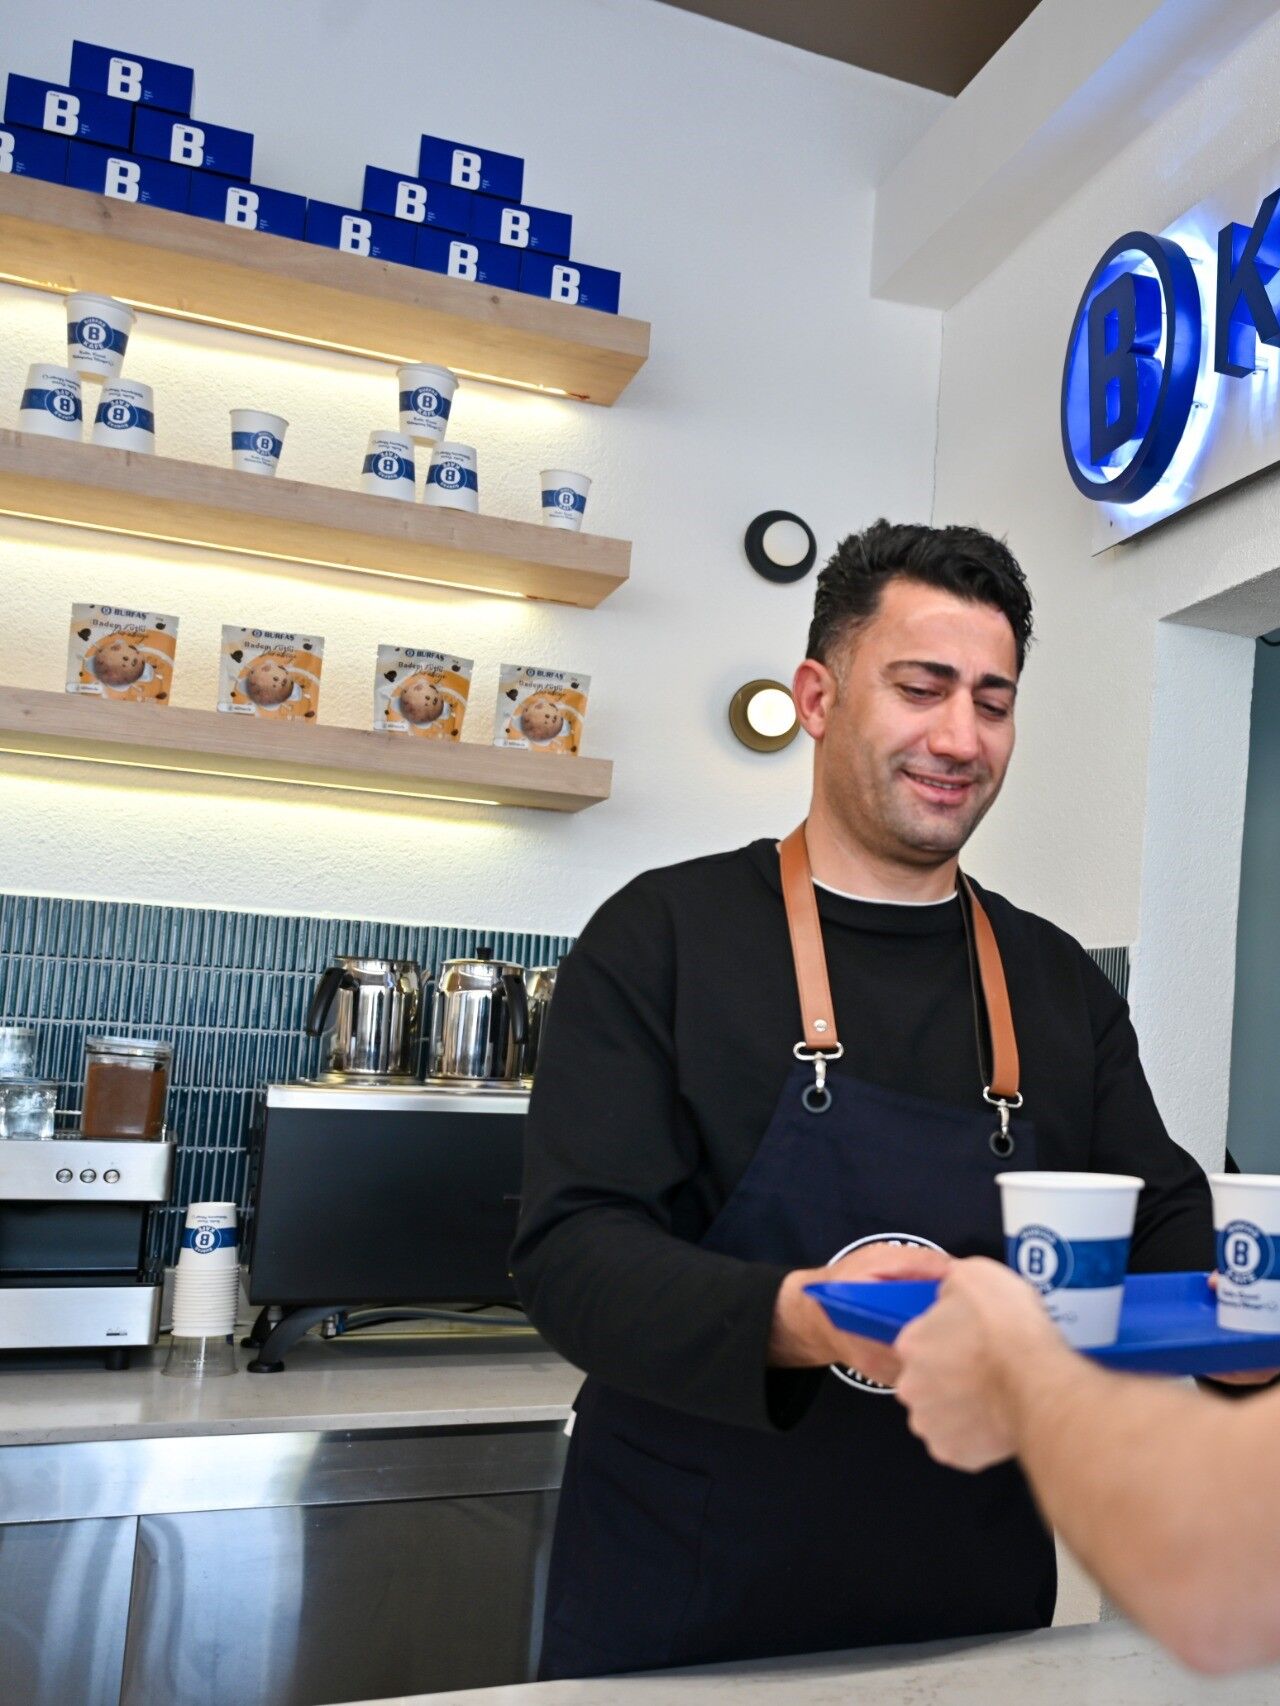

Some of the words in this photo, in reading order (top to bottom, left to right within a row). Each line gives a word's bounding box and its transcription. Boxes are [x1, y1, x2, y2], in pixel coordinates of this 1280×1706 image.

[107, 57, 143, 102] B
[42, 90, 80, 136] B
[170, 123, 205, 167] B
[105, 157, 141, 202] B
[451, 149, 482, 191] B
[225, 187, 259, 230] B
[395, 181, 427, 223] B
[339, 215, 372, 257] B
[500, 208, 530, 248] B
[447, 241, 479, 282] B
[550, 264, 581, 305] B
[88, 326, 100, 341] B
[1090, 272, 1162, 466] B
[60, 397, 71, 412] B
[113, 407, 124, 421] B
[422, 395, 433, 408] B
[261, 437, 270, 449] B
[383, 459, 393, 472] B
[445, 469, 455, 482] B
[200, 1234, 210, 1246] B
[1029, 1246, 1044, 1274] B
[1233, 1240, 1248, 1267] B
